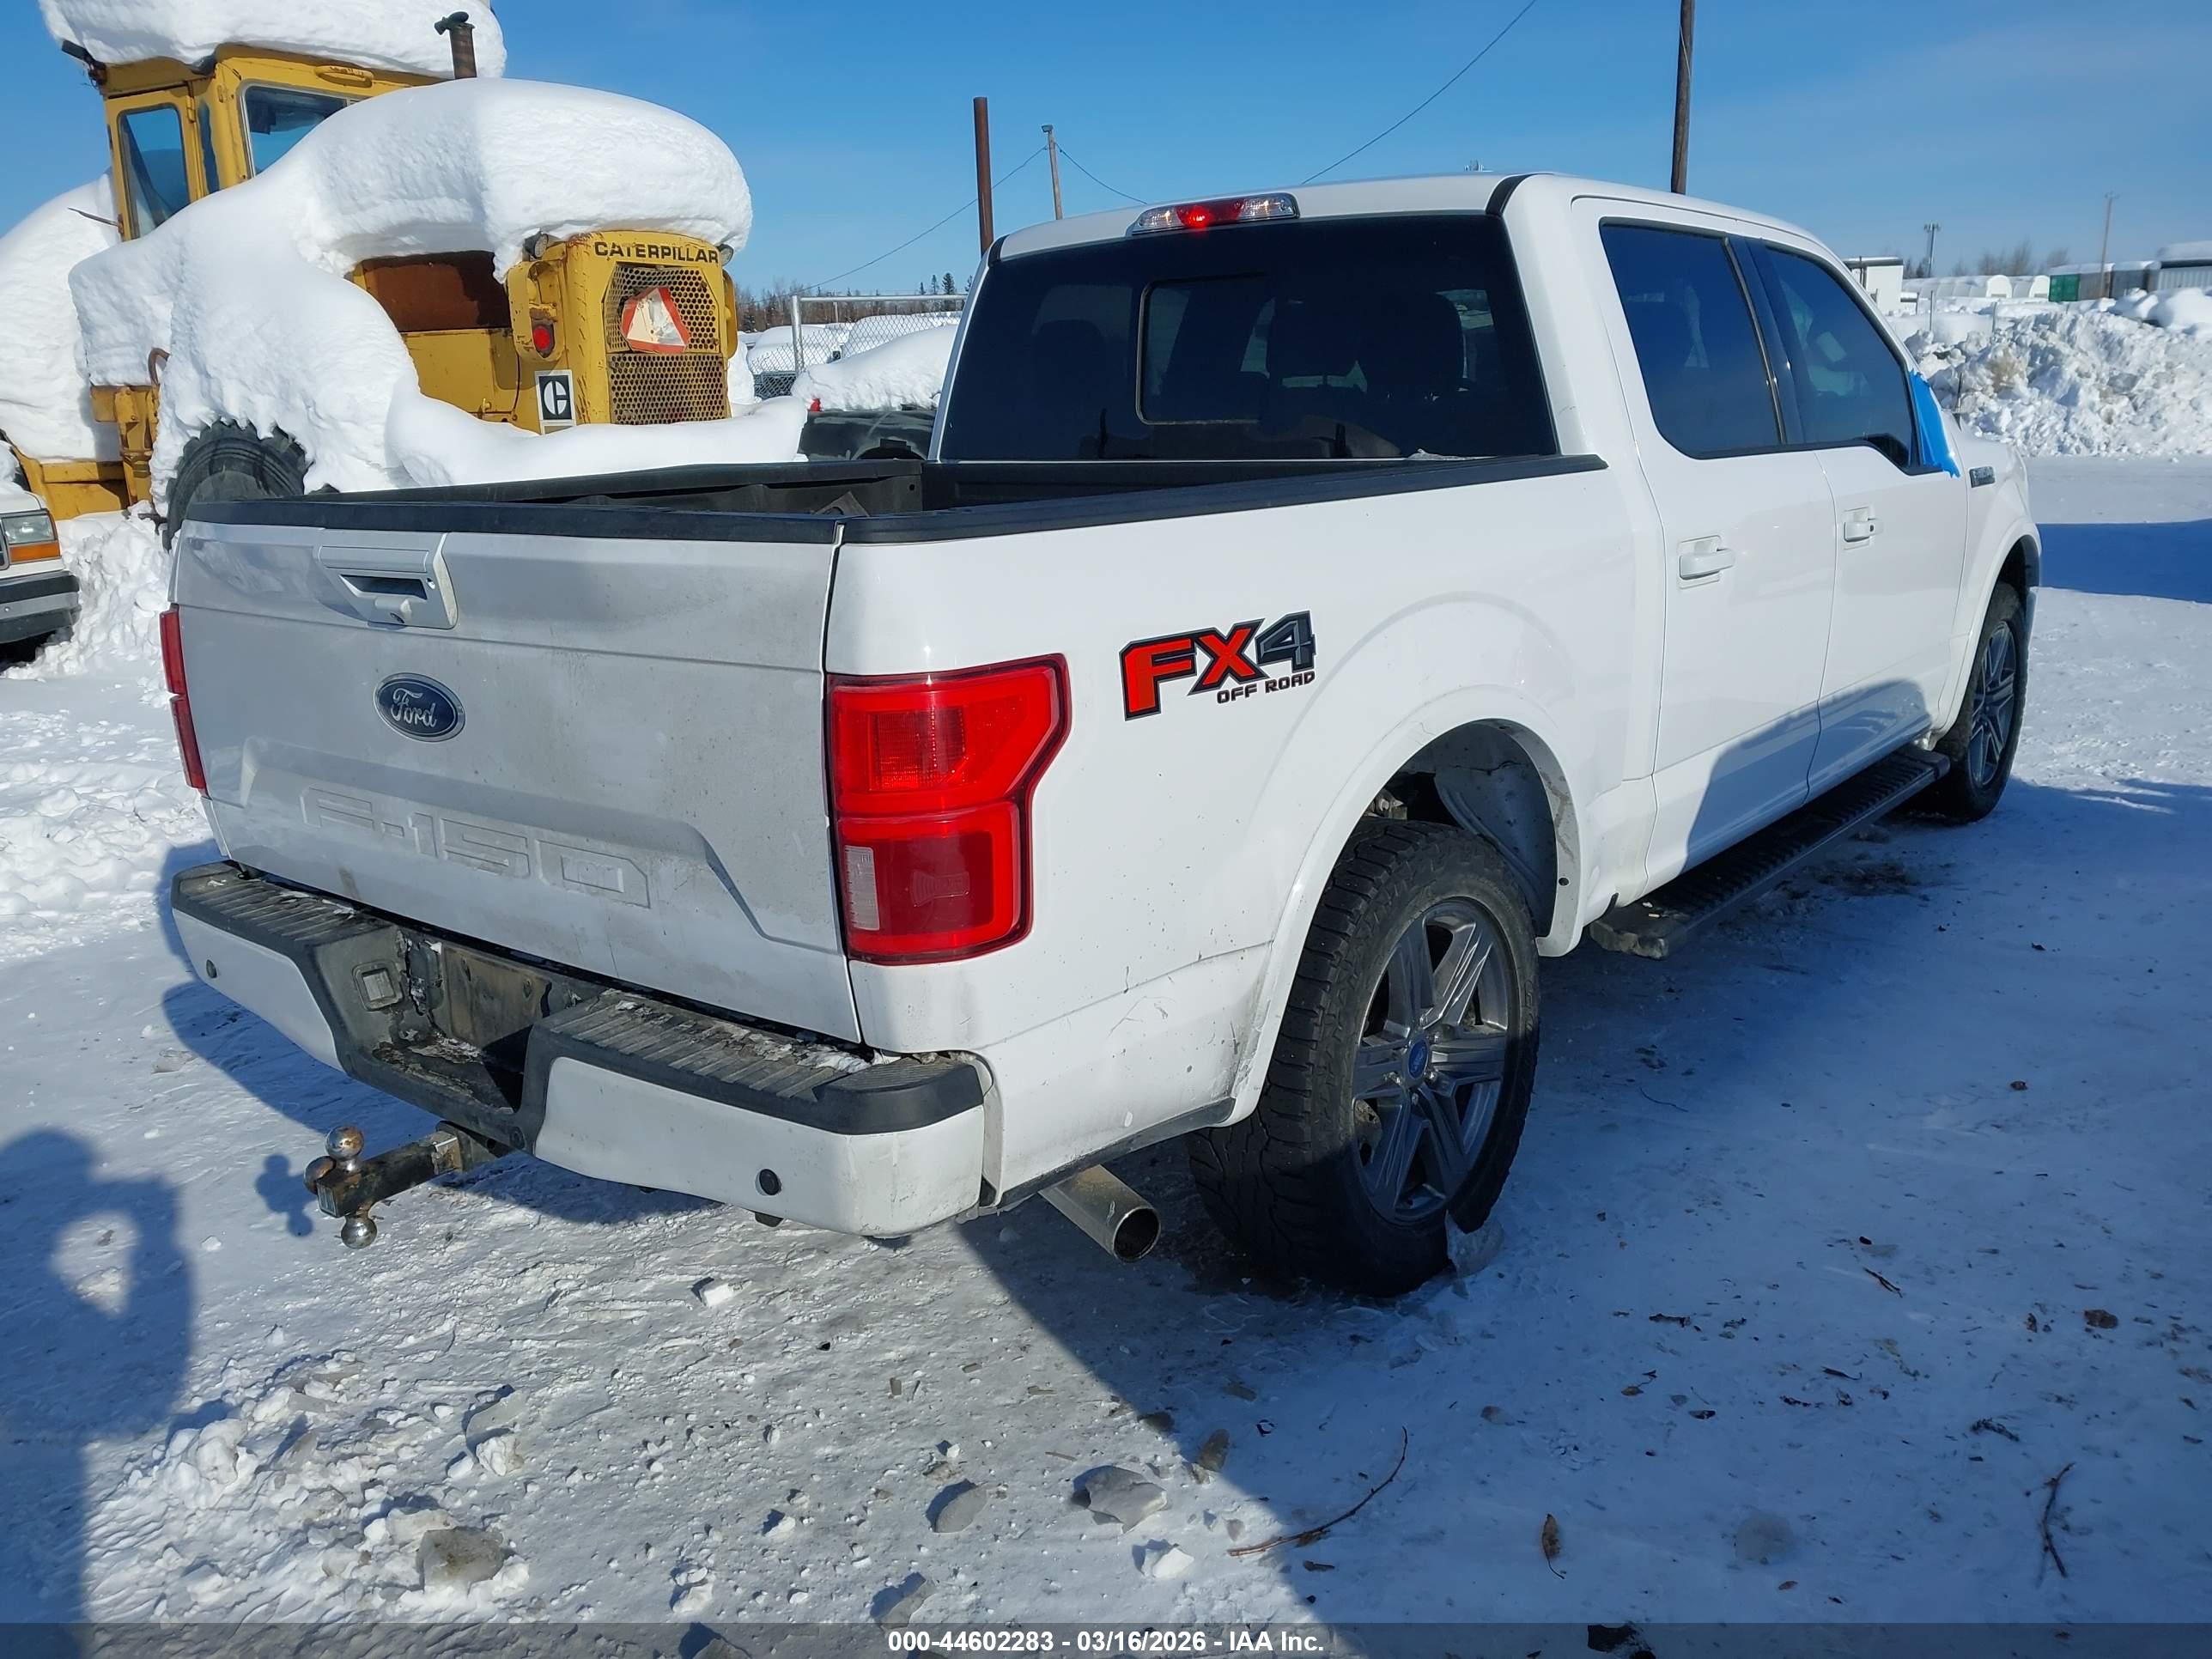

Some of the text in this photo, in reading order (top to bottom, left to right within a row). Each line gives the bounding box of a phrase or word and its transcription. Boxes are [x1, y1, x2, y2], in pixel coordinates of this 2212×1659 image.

[594, 241, 719, 263] CATERPILLAR
[1119, 610, 1317, 722] FX4
[1217, 671, 1316, 704] OFF ROAD
[391, 688, 437, 728] Ford
[299, 783, 651, 908] F-150
